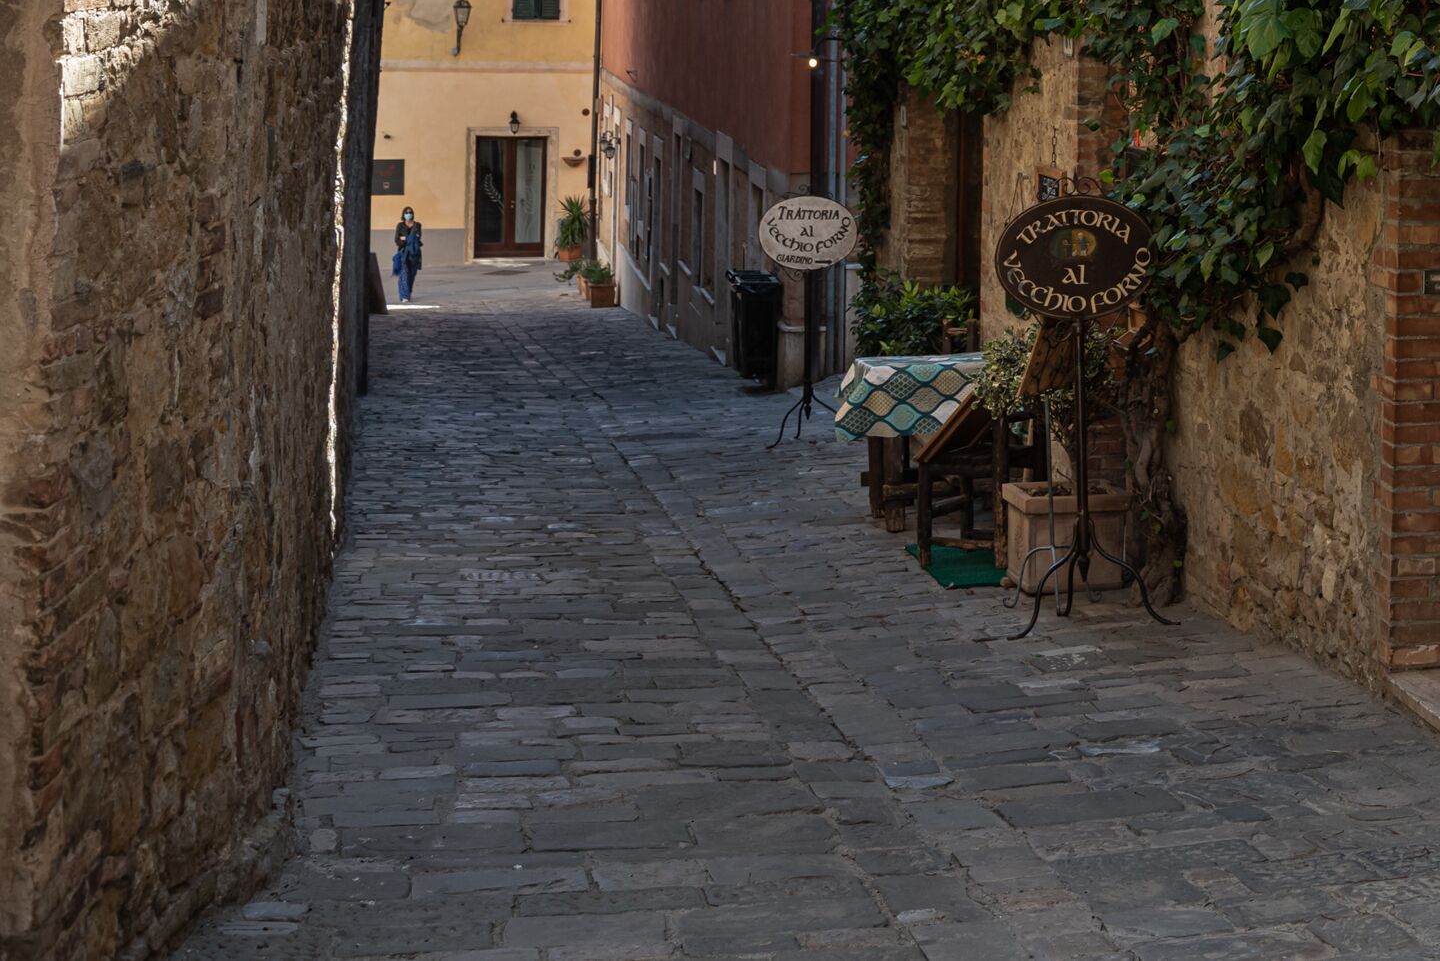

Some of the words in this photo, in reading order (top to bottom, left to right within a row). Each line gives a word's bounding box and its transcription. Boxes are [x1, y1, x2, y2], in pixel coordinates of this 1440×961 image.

[778, 205, 840, 220] TRATTORIA
[1016, 209, 1131, 245] TRATTORIA
[776, 254, 813, 265] GIARDINO
[1090, 247, 1151, 314] FORNO
